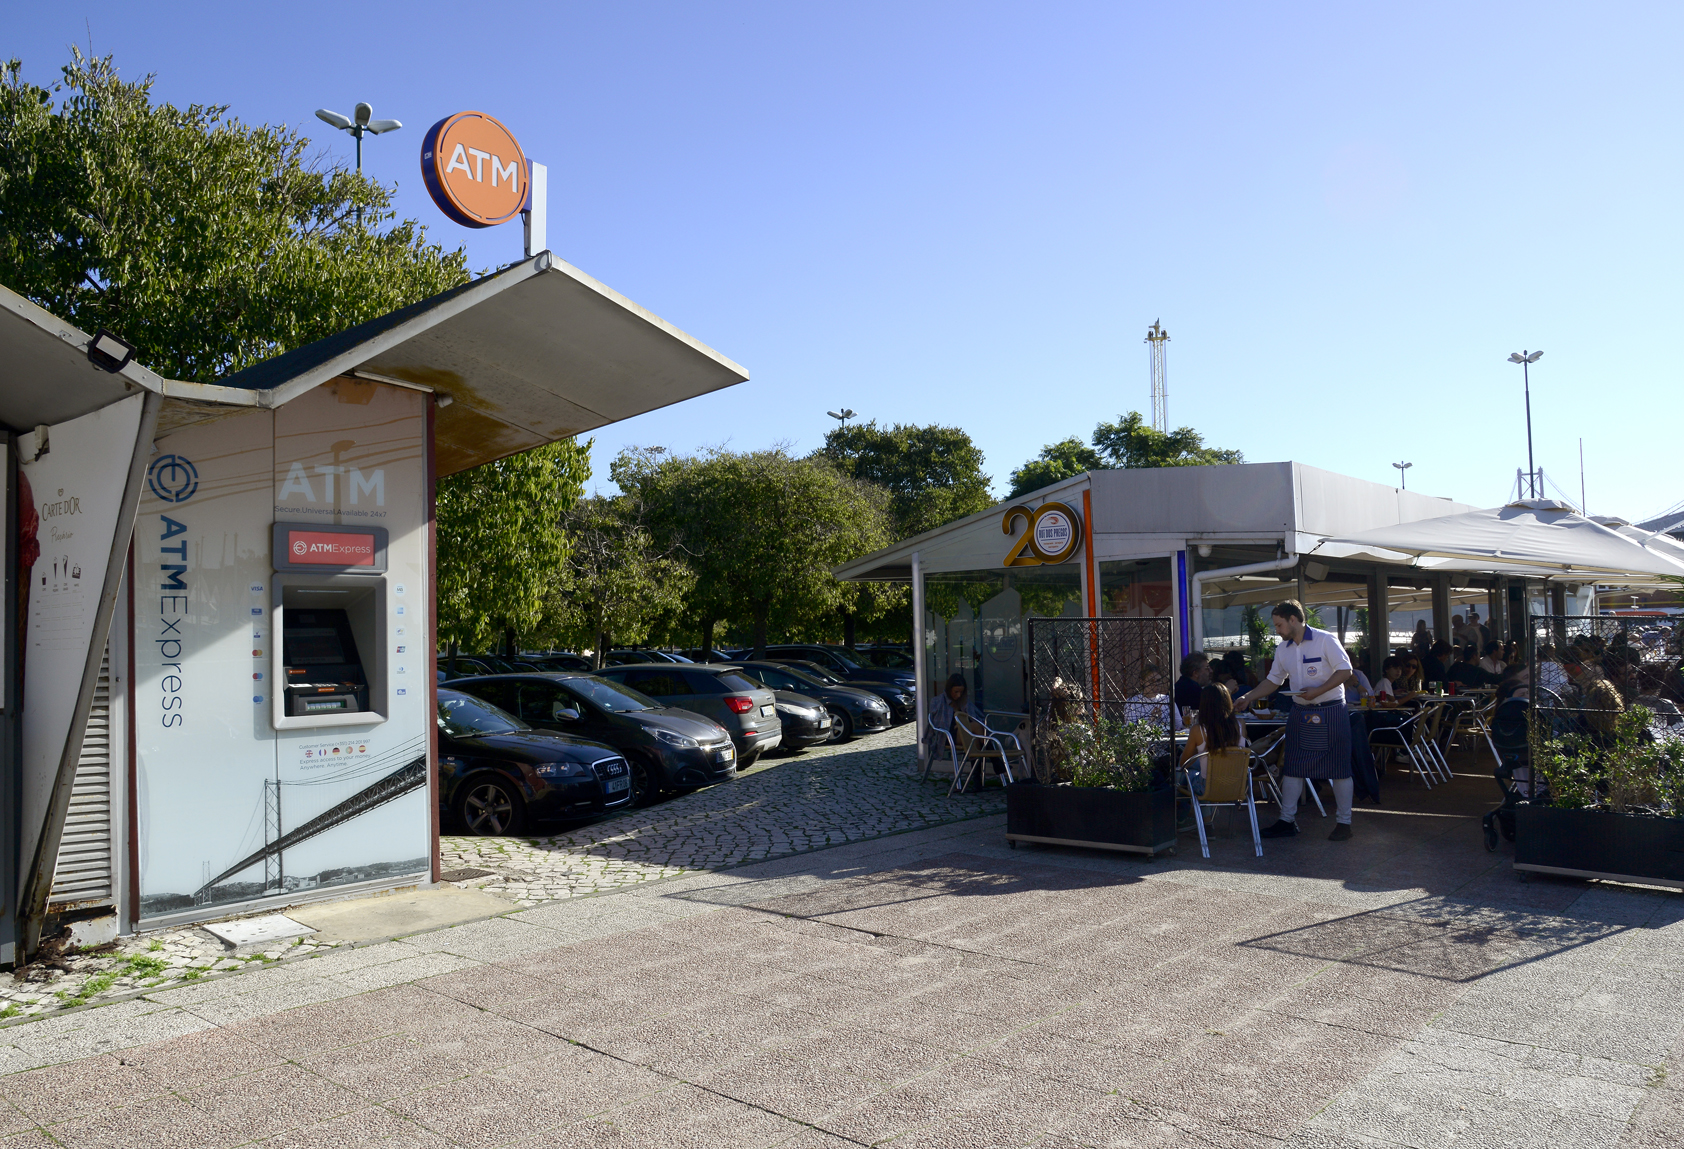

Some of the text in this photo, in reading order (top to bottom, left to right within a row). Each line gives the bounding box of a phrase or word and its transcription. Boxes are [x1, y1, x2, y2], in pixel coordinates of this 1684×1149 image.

[445, 142, 519, 194] ATM
[277, 461, 385, 507] ATM
[42, 501, 63, 521] CARTE
[370, 510, 387, 518] 24x7
[309, 543, 371, 555] ATMExpress
[1002, 501, 1081, 567] 20
[1053, 527, 1068, 538] PREGOS
[155, 514, 188, 728] ATMExpress
